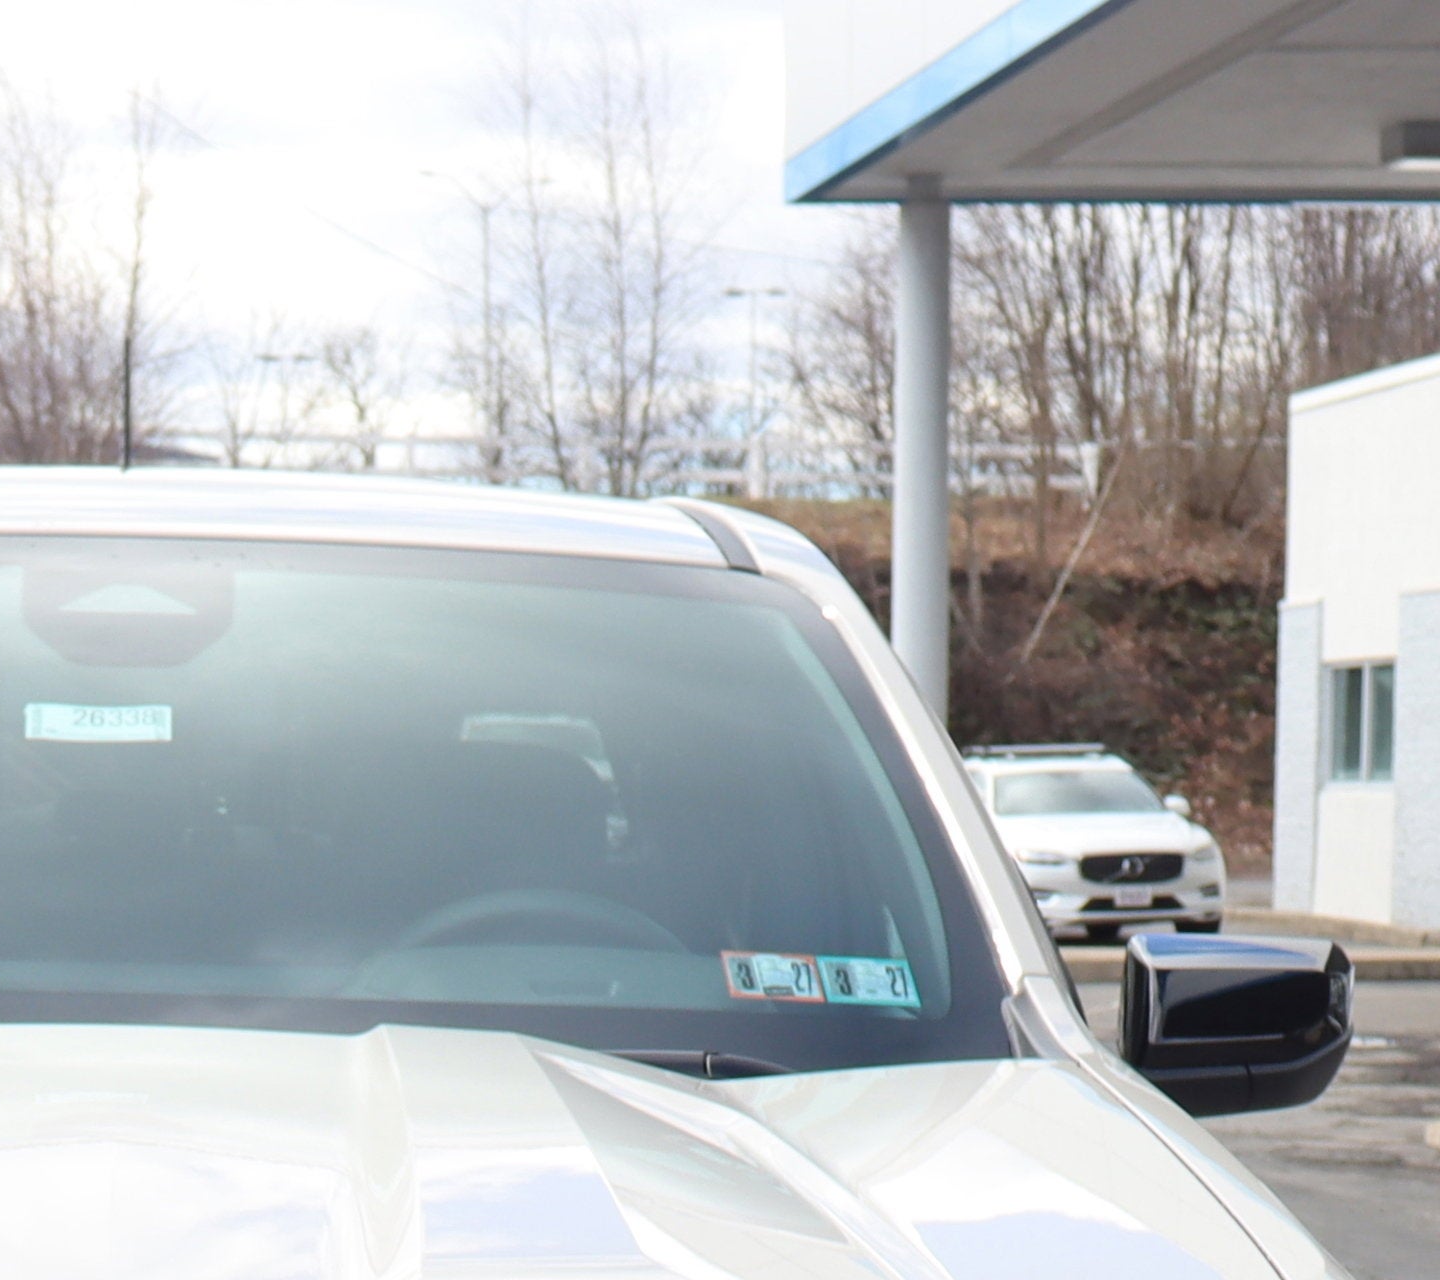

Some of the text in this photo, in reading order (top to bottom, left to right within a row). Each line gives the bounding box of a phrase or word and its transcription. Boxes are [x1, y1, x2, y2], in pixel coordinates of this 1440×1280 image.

[737, 961, 813, 994] 3 27
[835, 965, 909, 999] 3 27
